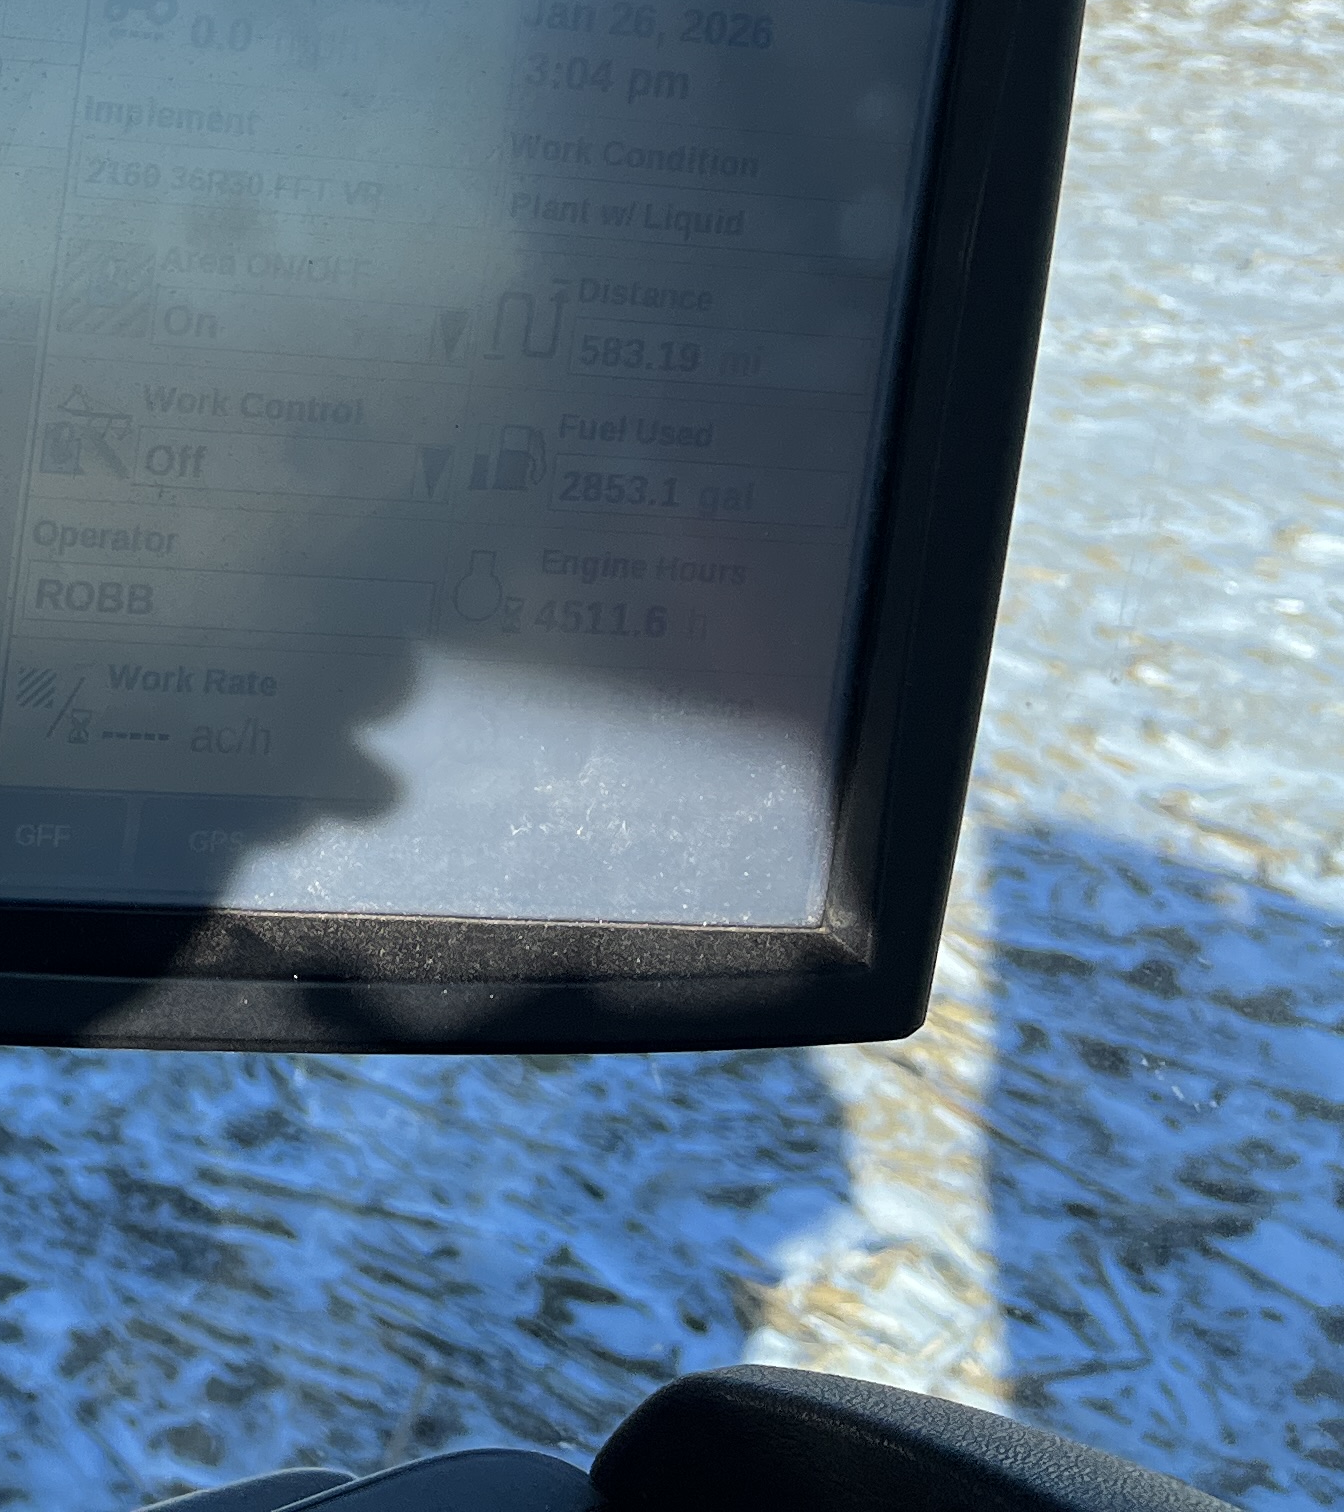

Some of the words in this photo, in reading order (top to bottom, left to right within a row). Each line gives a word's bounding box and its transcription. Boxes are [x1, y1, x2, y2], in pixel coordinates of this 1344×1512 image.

[190, 15, 253, 52] 0.0
[610, 0, 666, 44] 26,
[679, 7, 775, 50] 2026
[525, 53, 614, 92] 3:04
[626, 65, 690, 103] pm
[84, 94, 261, 136] Implement
[84, 155, 161, 189] 2160
[511, 131, 592, 167] Work
[602, 140, 760, 180] Condition
[511, 192, 590, 226] Plant
[601, 200, 638, 226] w/
[643, 202, 746, 240] Liquid
[160, 246, 237, 277] Area
[578, 277, 714, 314] Distance
[163, 304, 219, 340] On
[579, 335, 701, 374] 583.19
[718, 345, 762, 377] mi
[141, 383, 229, 419] Work
[239, 392, 364, 426] Control
[559, 413, 626, 446] Fuel
[635, 418, 714, 451] Used
[144, 441, 208, 479] Off
[559, 471, 682, 510] 2853.1
[697, 481, 755, 517] gal
[32, 518, 179, 556] Operator
[540, 548, 647, 585] Engine
[654, 555, 748, 587] Hours
[34, 577, 155, 616] ROBB
[534, 599, 669, 639] 4511.6
[108, 663, 194, 697] Work
[203, 667, 279, 698] Rate
[189, 717, 273, 757] ac/h
